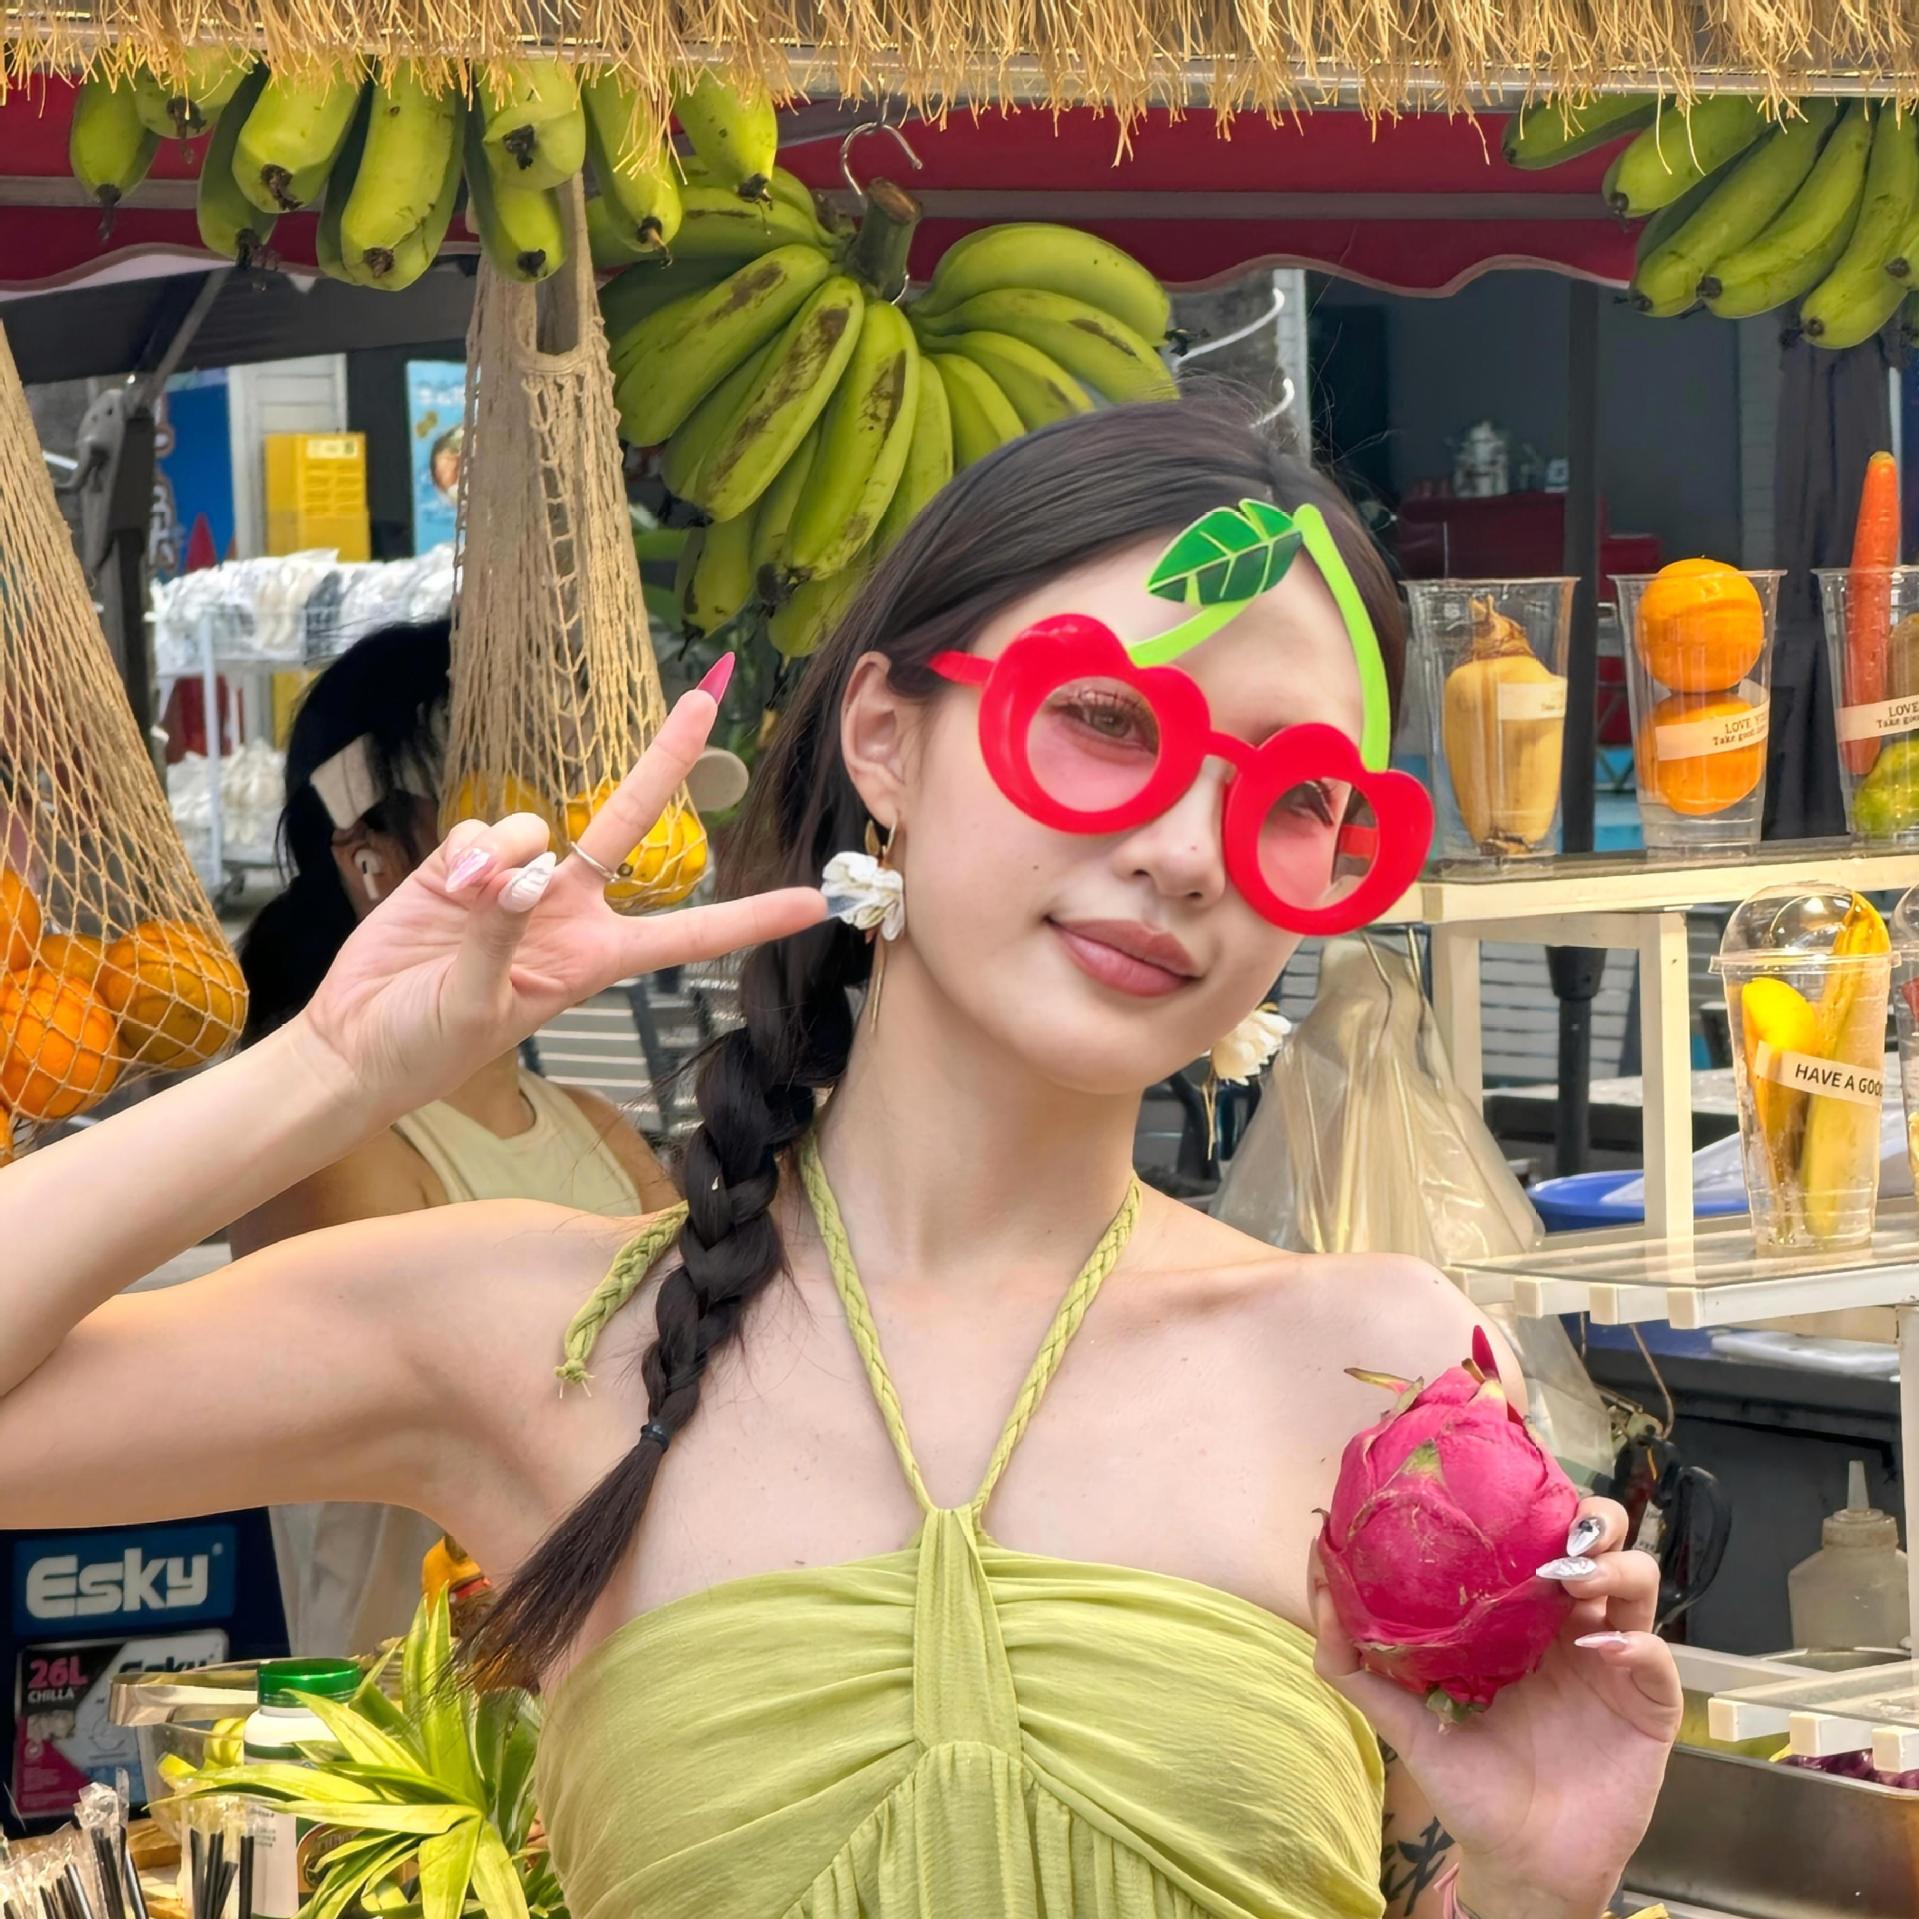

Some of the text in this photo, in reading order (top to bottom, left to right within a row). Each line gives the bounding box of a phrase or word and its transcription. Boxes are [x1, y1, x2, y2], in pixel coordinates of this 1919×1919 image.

[1888, 701, 1919, 717] LOVE
[1725, 718, 1751, 734] LOVE
[1876, 717, 1900, 729] Take
[1713, 735, 1735, 746] Take
[1795, 1063, 1883, 1097] HAVE A GOO
[26, 1547, 209, 1619] Esky
[29, 1656, 88, 1690] 26L
[28, 1688, 76, 1704] CHILLA
